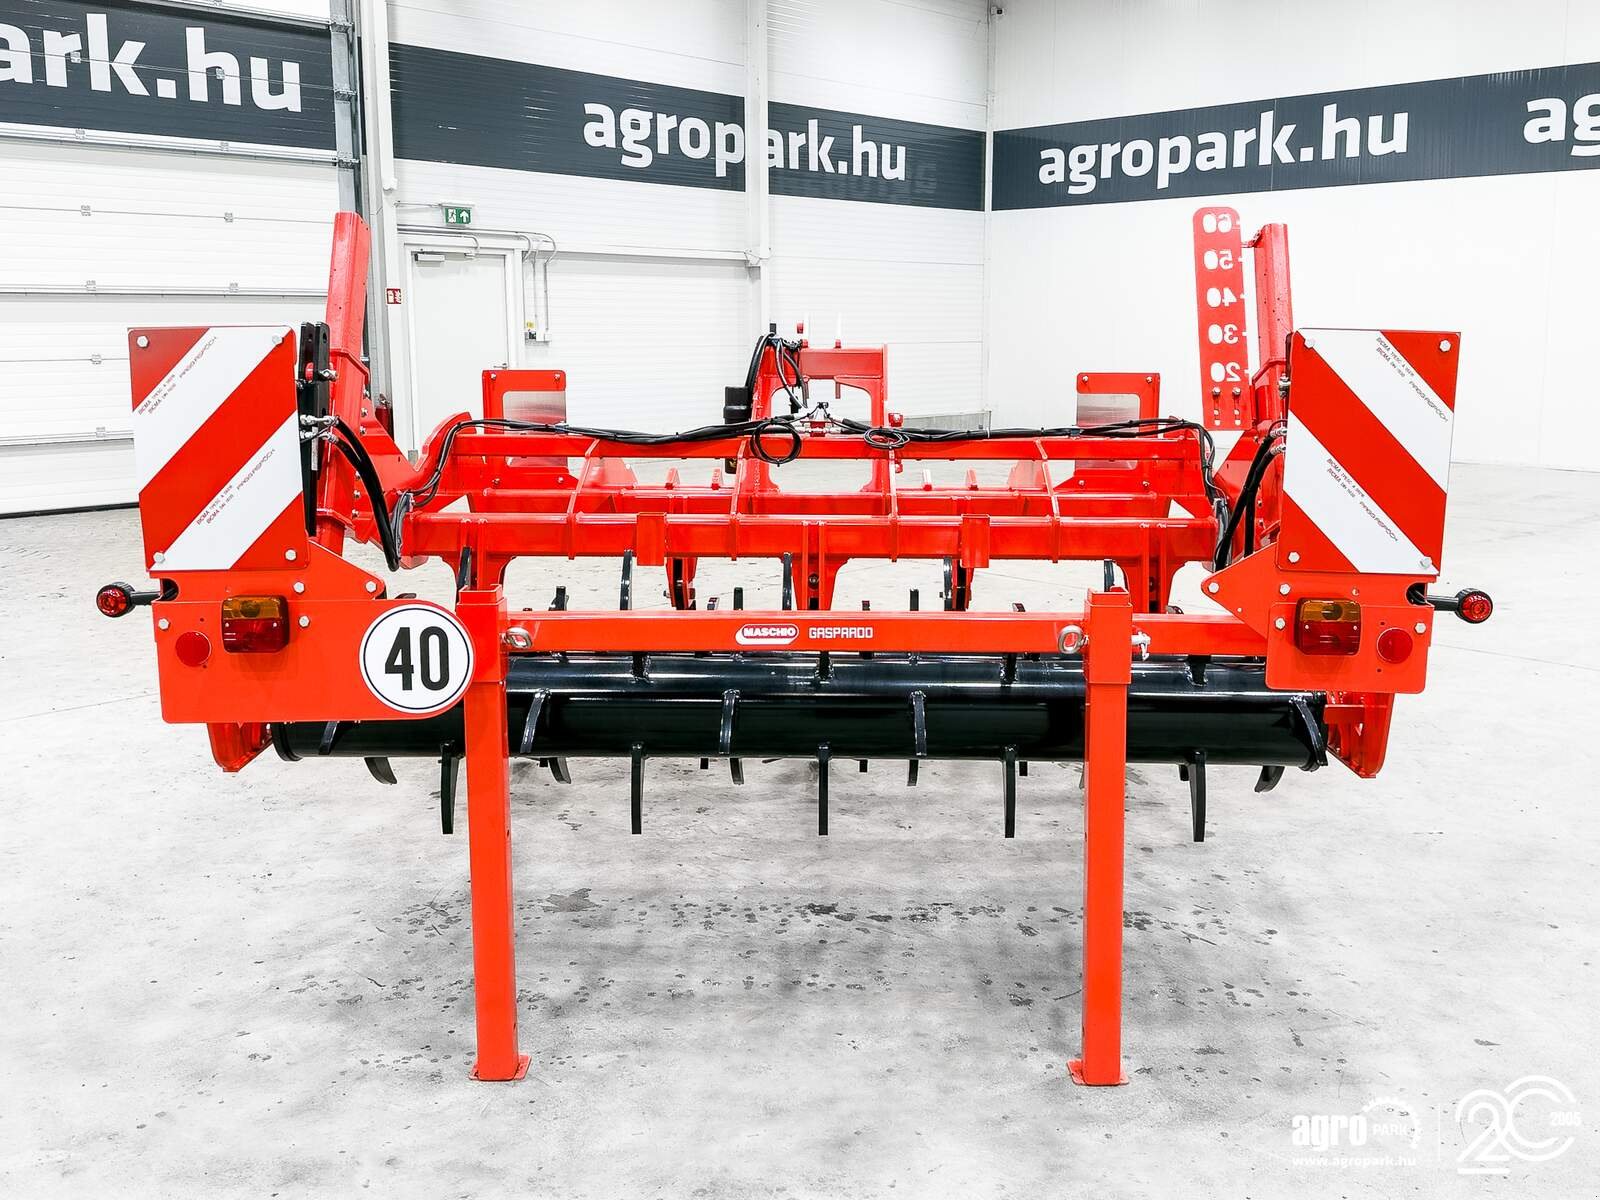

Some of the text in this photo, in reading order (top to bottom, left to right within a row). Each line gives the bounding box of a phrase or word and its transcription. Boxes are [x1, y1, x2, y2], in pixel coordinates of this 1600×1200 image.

[583, 103, 907, 182] agropark.hu
[1038, 103, 1409, 195] agropark.hu
[384, 626, 450, 691] 40
[743, 627, 874, 639] MASCHIO GASPARDO
